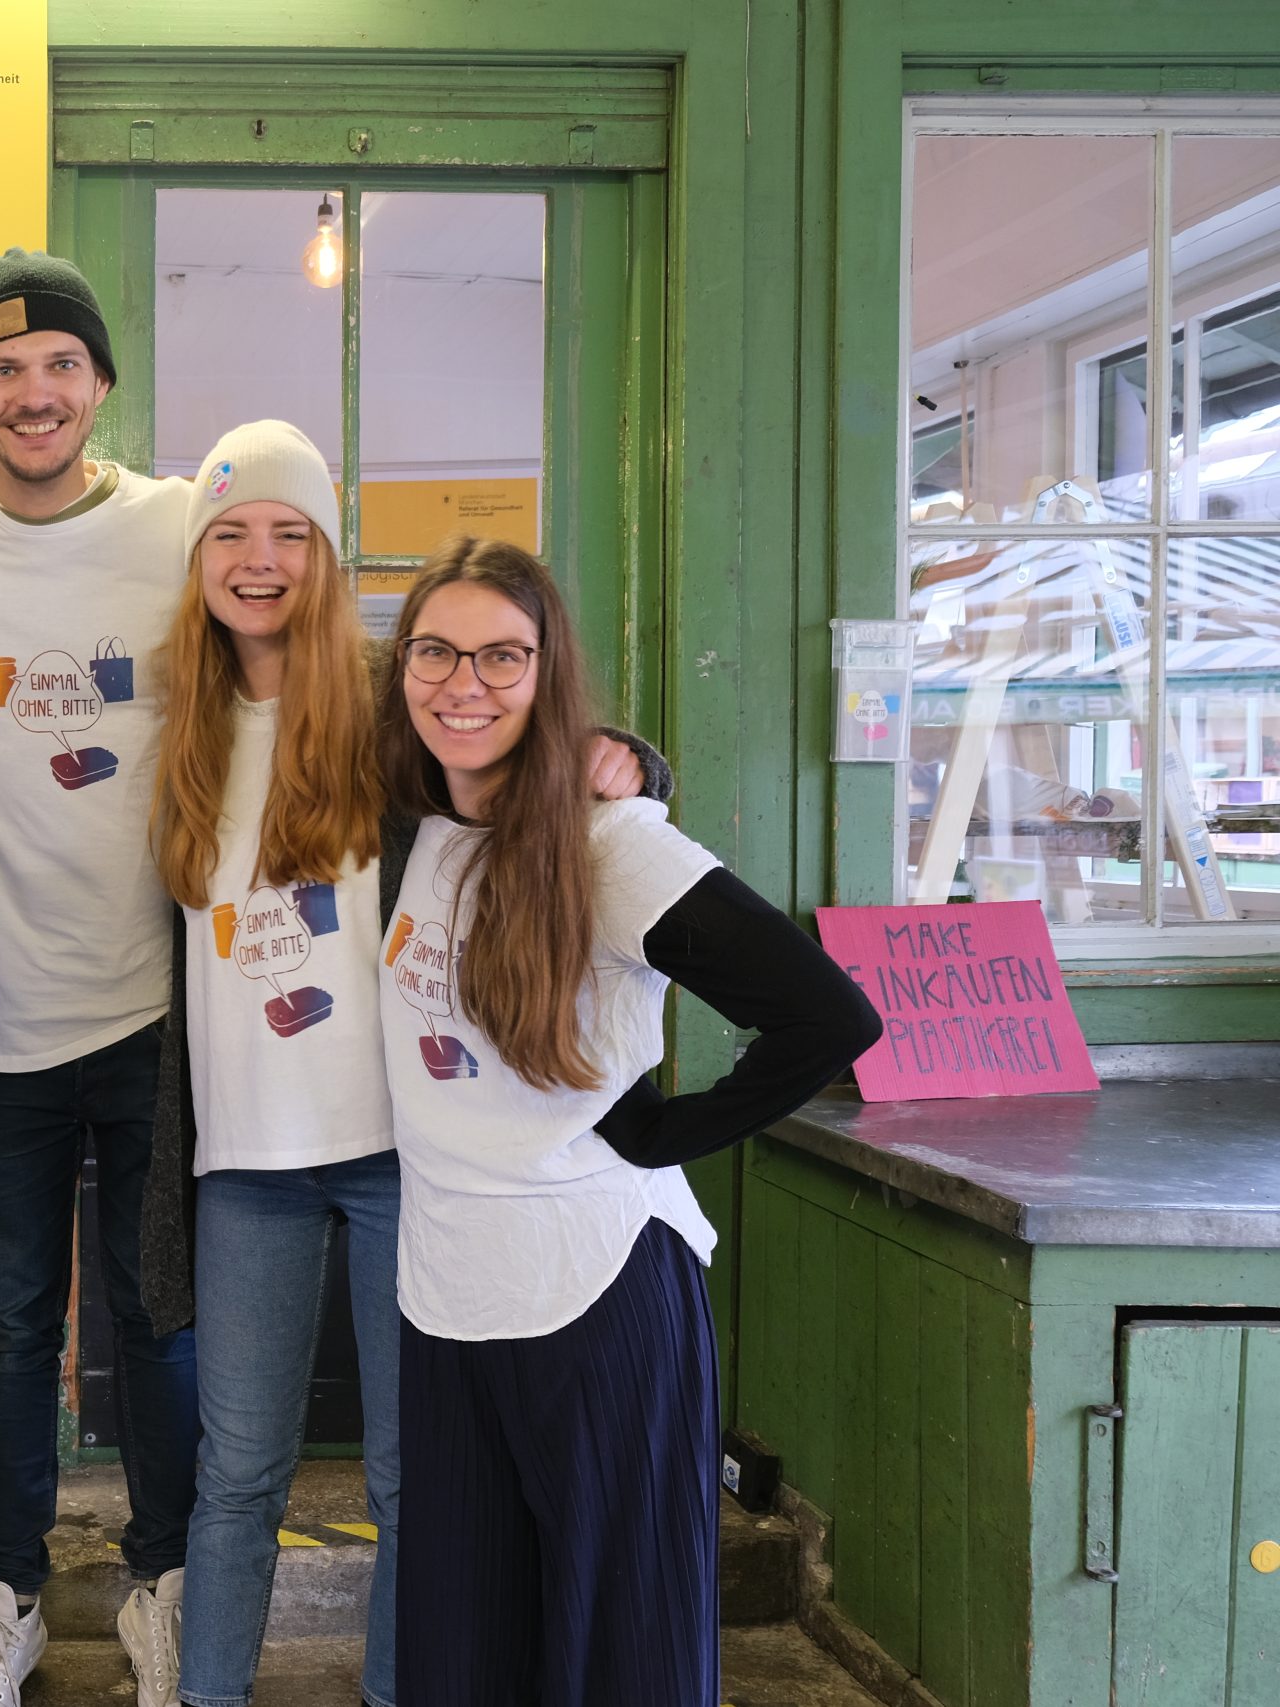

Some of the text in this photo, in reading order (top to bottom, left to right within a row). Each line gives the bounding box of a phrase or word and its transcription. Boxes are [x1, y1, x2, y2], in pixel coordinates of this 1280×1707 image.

[30, 673, 80, 691] EINMAL
[17, 699, 96, 719] OHNE, BITTE
[247, 908, 286, 934] EINMAL
[239, 933, 305, 966] OHNE, BITTE
[413, 940, 447, 971] EINMAL
[884, 921, 976, 959] MAKE
[398, 964, 424, 998] OHNE,
[886, 1015, 1063, 1075] PLASTIKFREI
